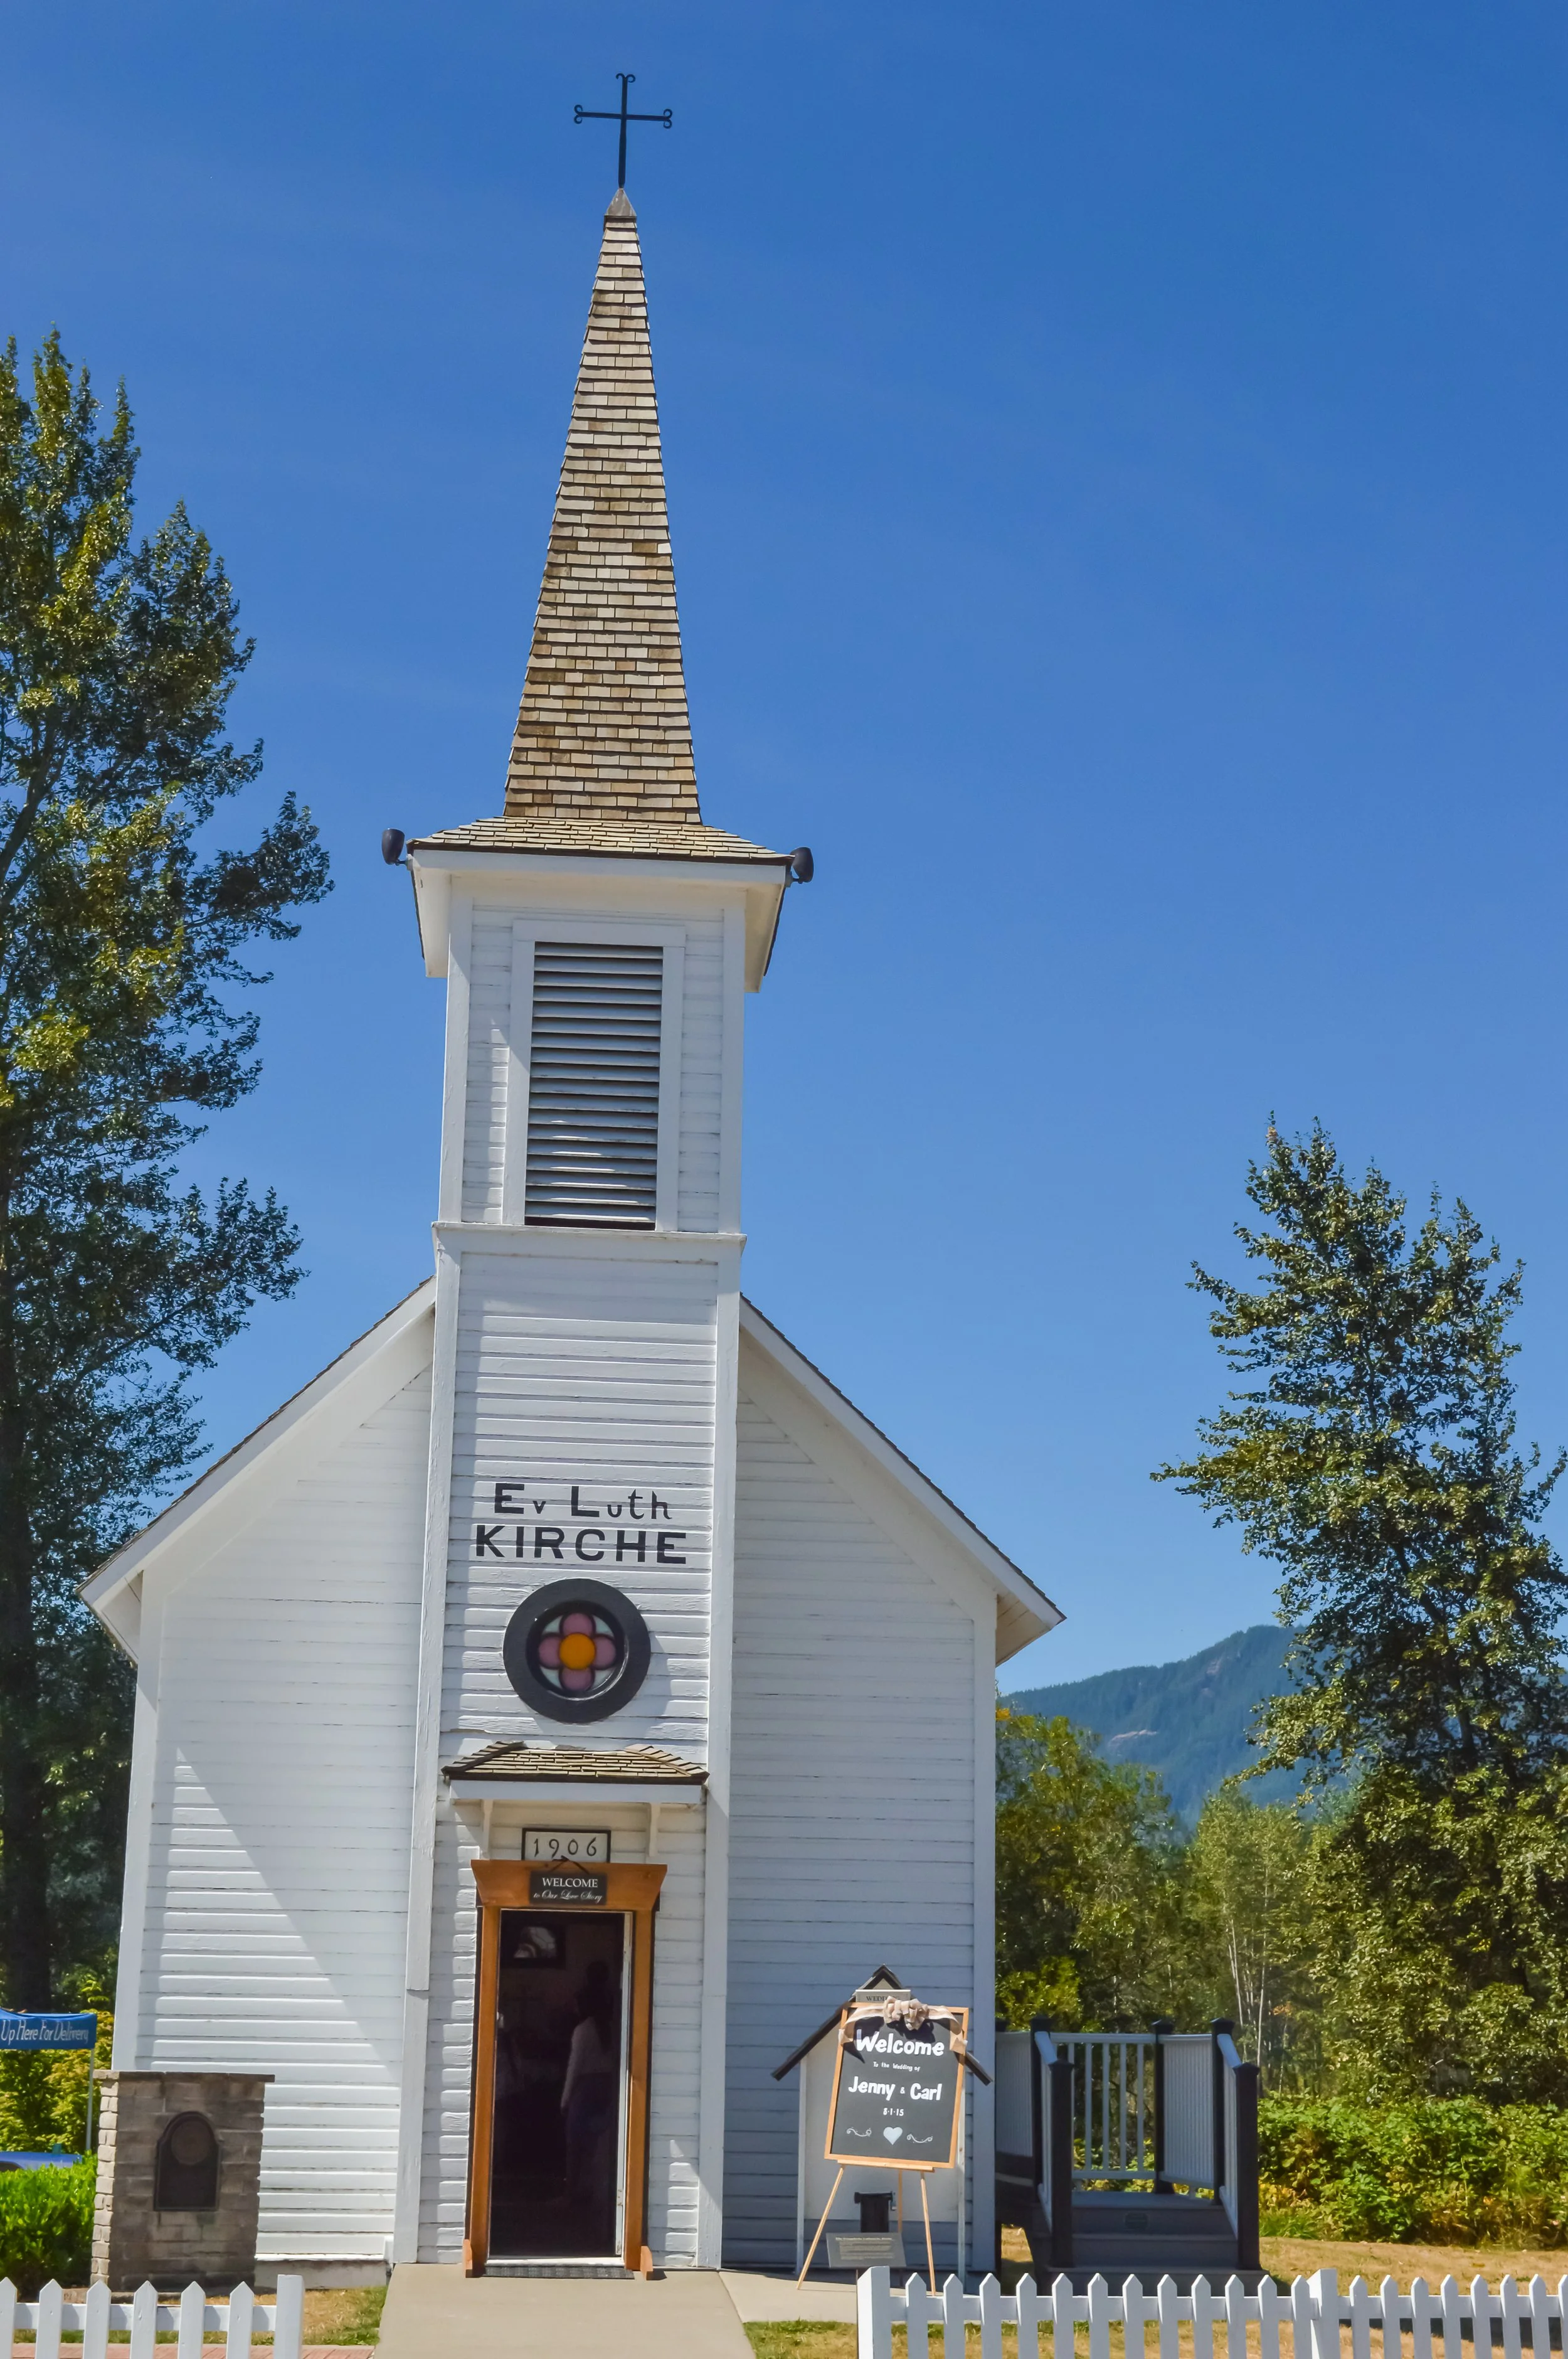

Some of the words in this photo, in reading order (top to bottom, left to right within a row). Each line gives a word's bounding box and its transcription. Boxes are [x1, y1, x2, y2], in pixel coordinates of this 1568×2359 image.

[494, 1483, 546, 1515] Ev
[571, 1486, 672, 1520] Luth
[476, 1525, 686, 1565] KIRCHE
[534, 1837, 596, 1858] 1906
[542, 1878, 598, 1888] WELCOME
[542, 1889, 558, 1899] Our
[560, 1890, 578, 1900] Love
[581, 1891, 602, 1904] Story
[1, 2019, 15, 2045] Up
[16, 2019, 38, 2040] Here
[39, 2019, 54, 2040] For
[54, 2021, 88, 2044] Delivery
[856, 2028, 945, 2056] Welcome
[893, 2063, 913, 2072] Wedding
[848, 2076, 896, 2101] Jenny
[910, 2082, 942, 2101] Carl
